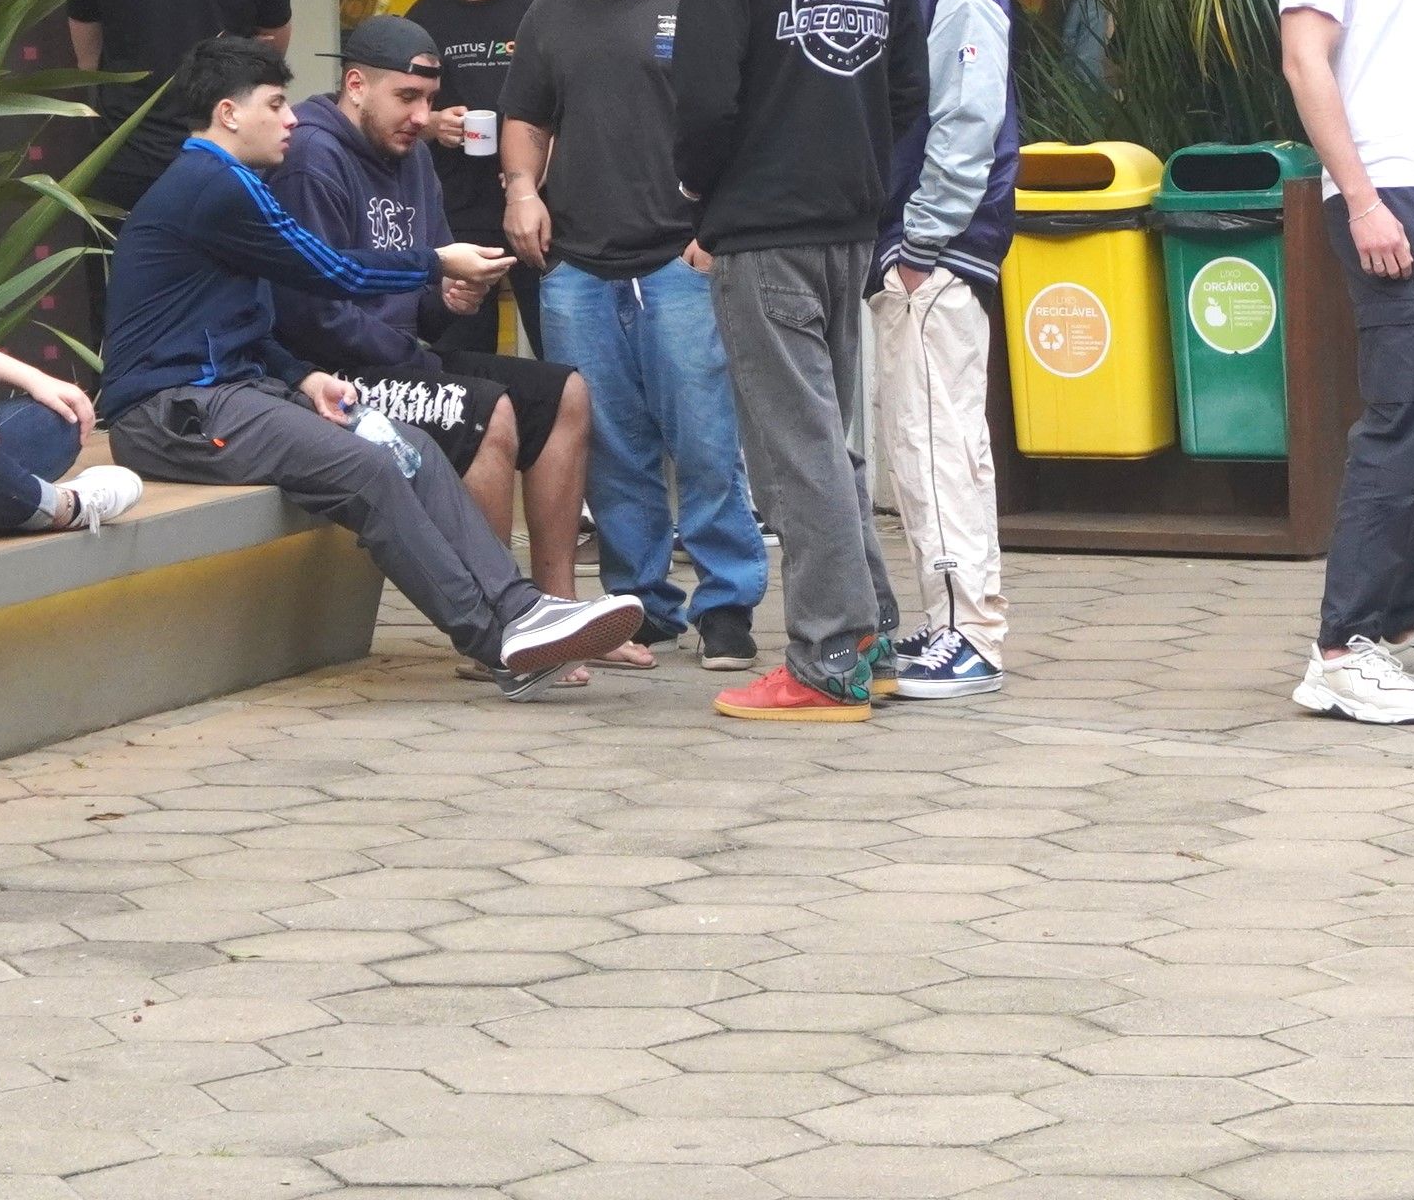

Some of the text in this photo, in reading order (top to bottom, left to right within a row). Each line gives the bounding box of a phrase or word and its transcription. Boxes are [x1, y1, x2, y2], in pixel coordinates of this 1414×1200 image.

[776, 4, 889, 40] LOCOOTION
[444, 42, 486, 56] ATITUS
[1203, 280, 1259, 292] ORGÂNICO
[1035, 305, 1098, 317] RECICLÁVEL
